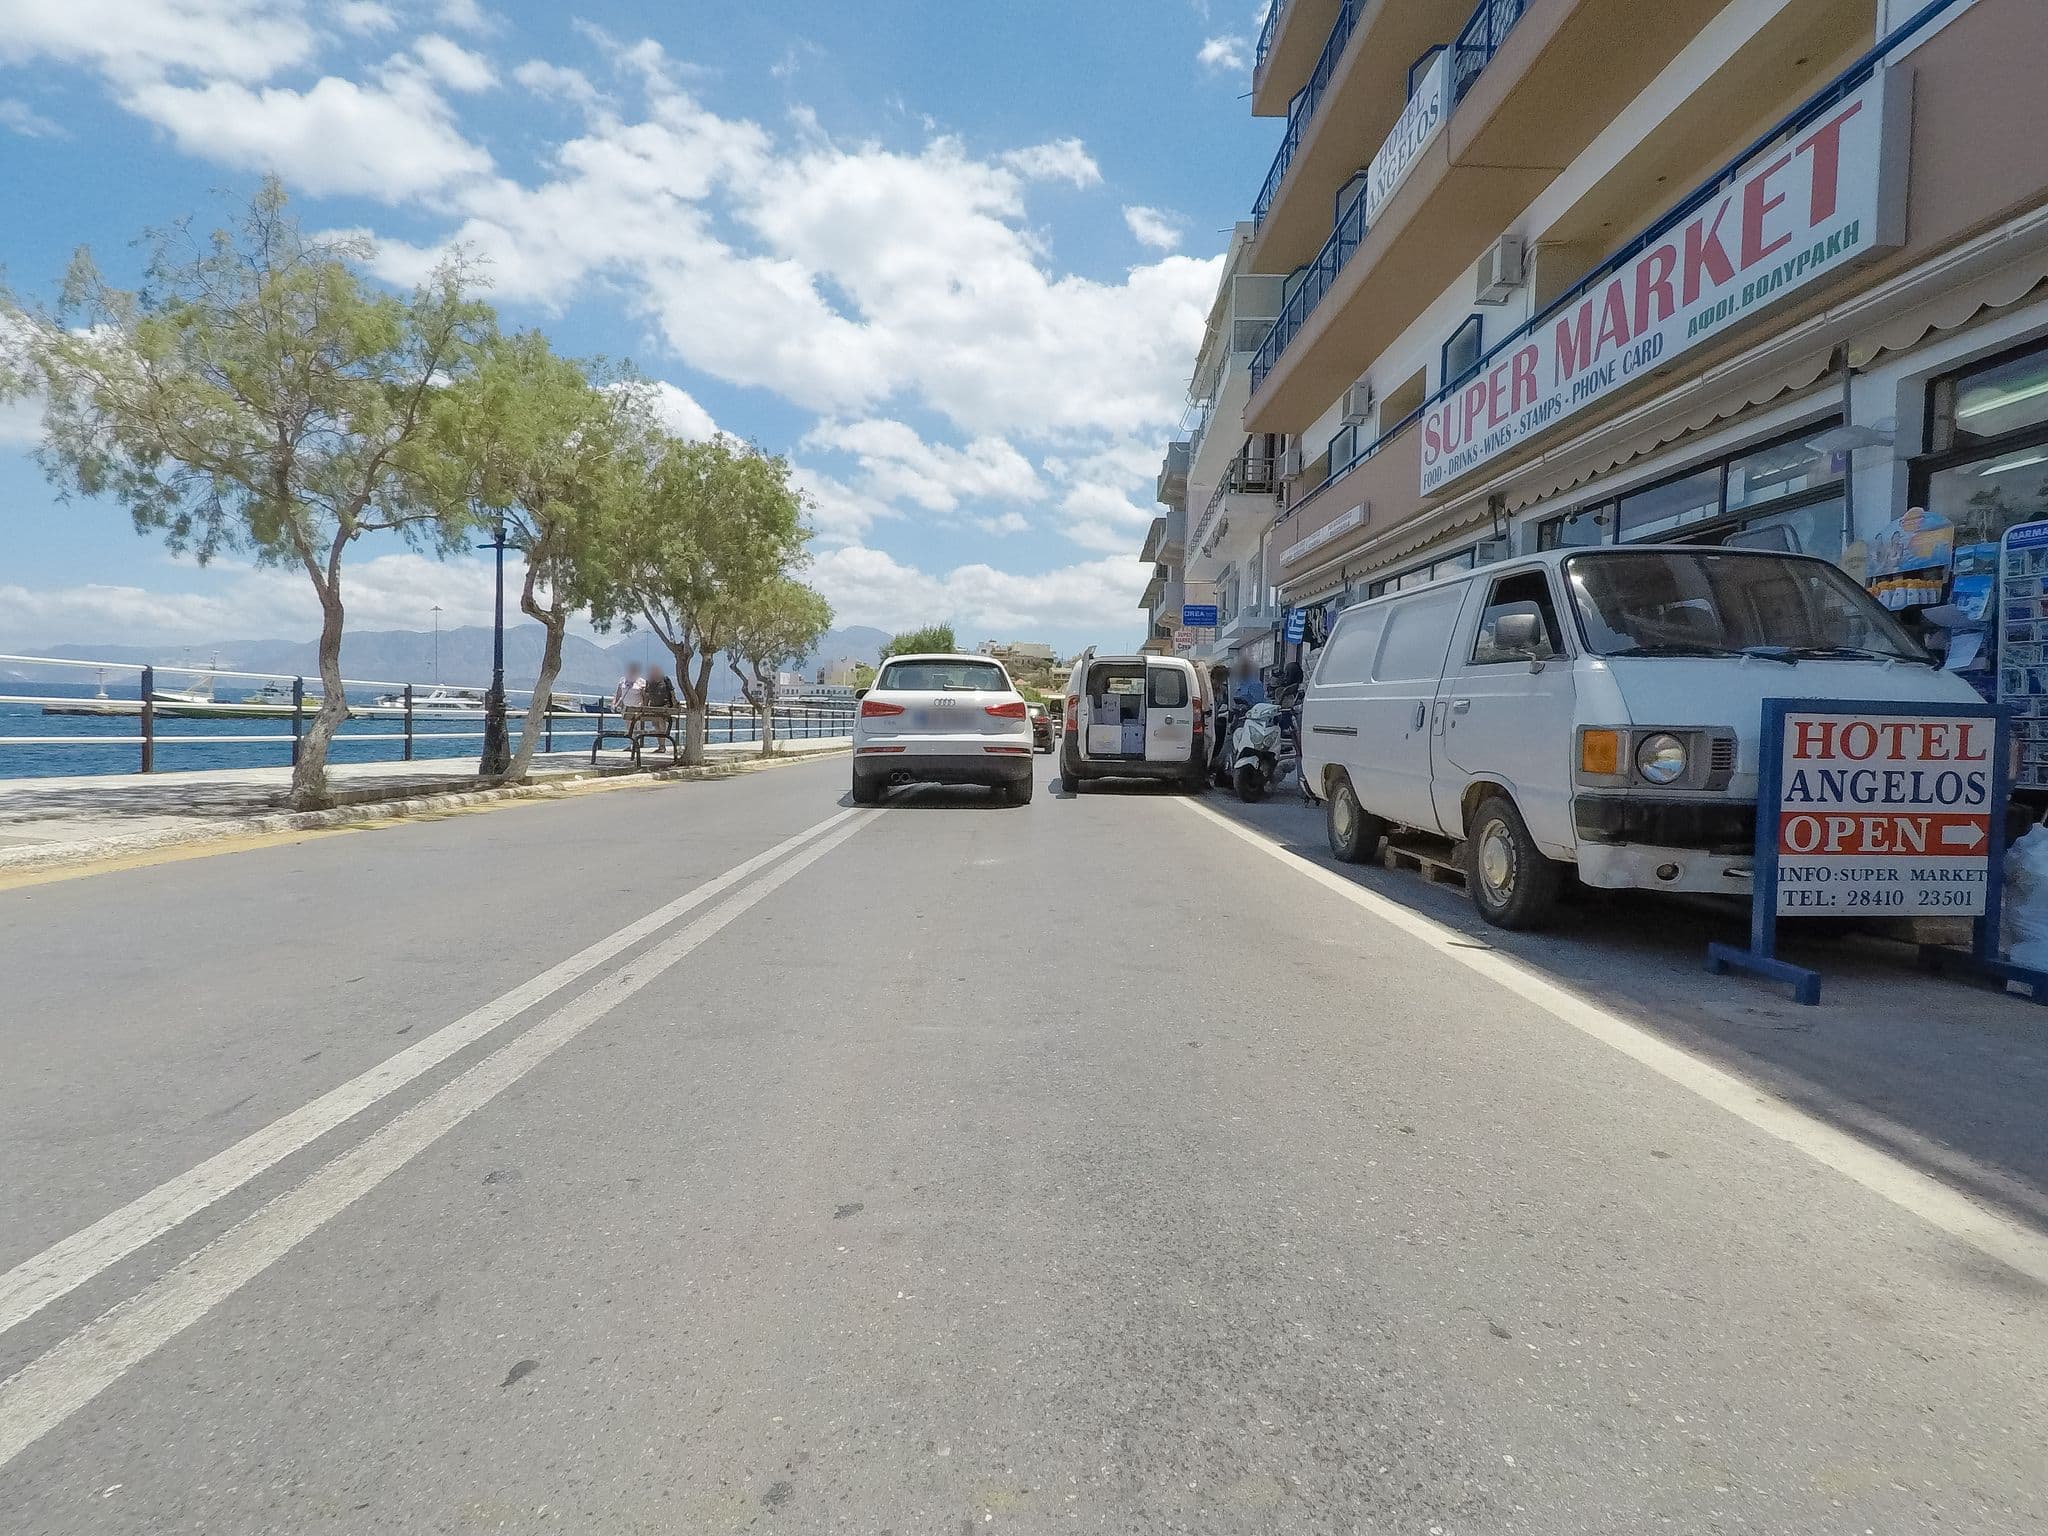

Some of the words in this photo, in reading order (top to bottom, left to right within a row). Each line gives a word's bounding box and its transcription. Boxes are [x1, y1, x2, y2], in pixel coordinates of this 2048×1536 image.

[1378, 89, 1424, 172] HOTEL
[1367, 91, 1439, 216] ANGELOS
[1424, 344, 1539, 467] SUPER
[1555, 100, 1863, 387] MARKET
[1423, 469, 1443, 490] FOOD
[1448, 444, 1479, 476] DRINKS
[1483, 423, 1512, 457] WINES
[1519, 393, 1563, 436] STAMPS
[1571, 364, 1617, 407] PHONE
[1622, 331, 1664, 374] CARD
[1792, 721, 1987, 761] HOTEL
[1783, 769, 1986, 805] ANGELOS
[1784, 815, 1932, 853] OPEN
[1910, 868, 1988, 882] MARKET
[1783, 890, 1836, 907] TEL:
[1847, 890, 1904, 907] 28410
[1918, 890, 1973, 907] 23501
